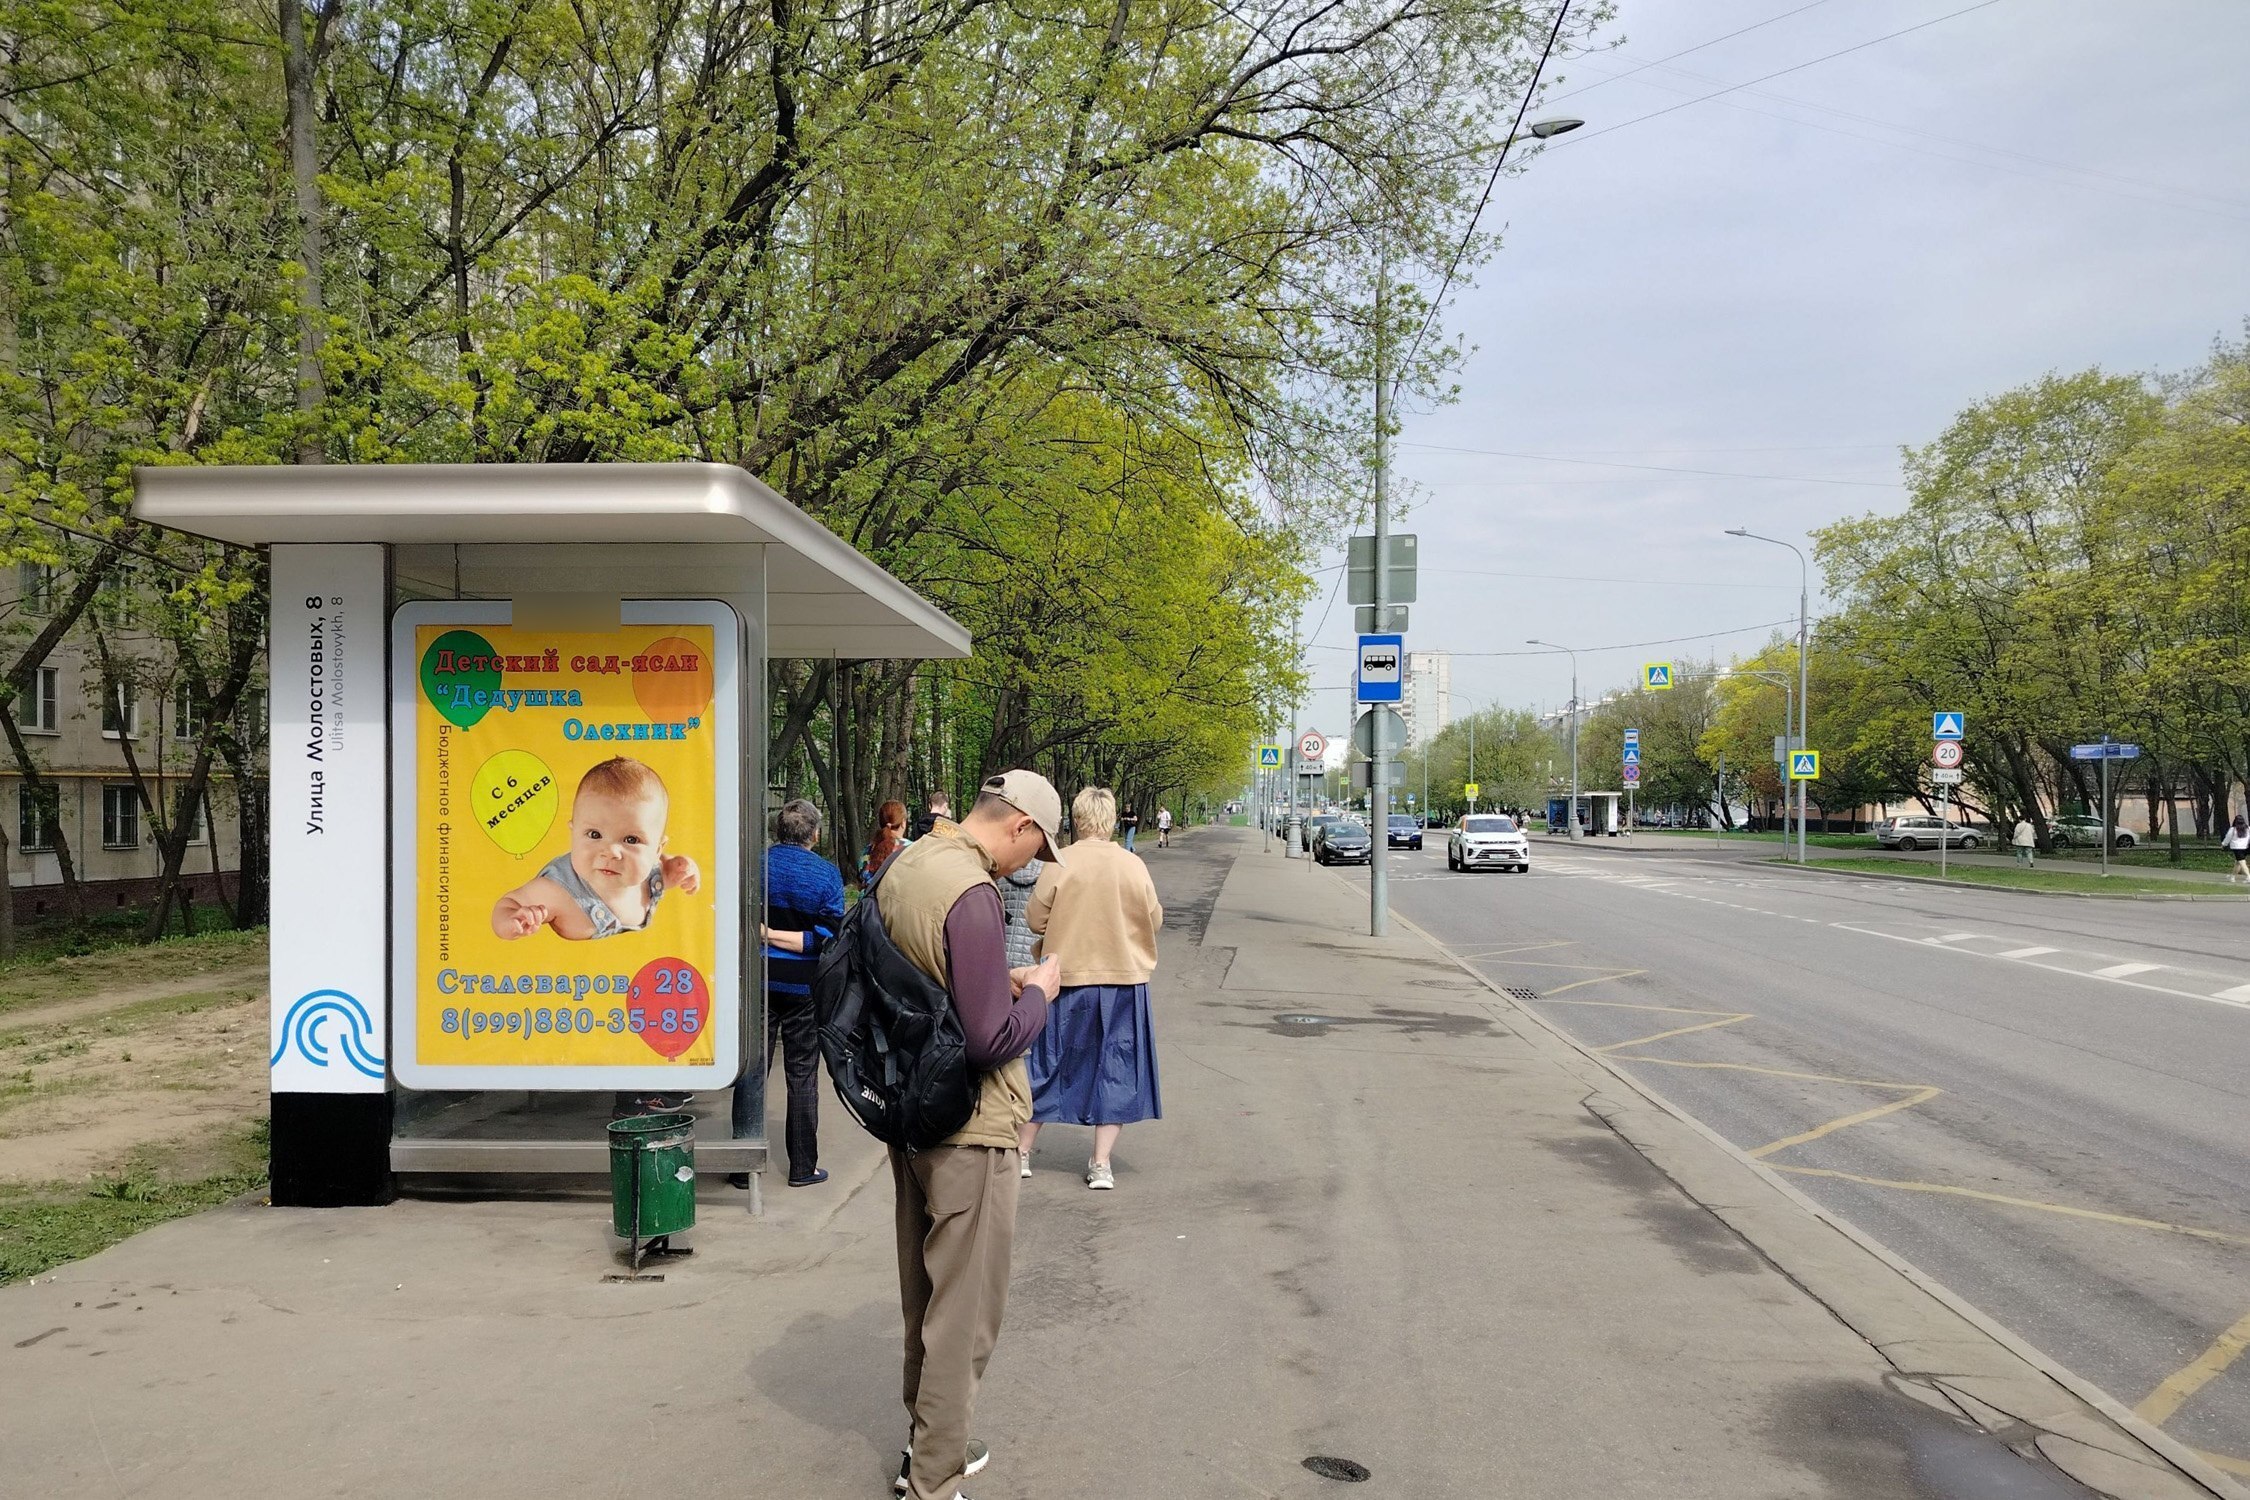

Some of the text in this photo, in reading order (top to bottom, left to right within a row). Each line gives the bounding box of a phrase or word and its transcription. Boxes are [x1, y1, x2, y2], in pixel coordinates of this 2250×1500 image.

[329, 596, 346, 751] Ulitsa Molostovykh, 8
[433, 648, 699, 676] Детский сад-ясли
[306, 596, 326, 835] Улица Молостовых, 8
[1305, 740, 1319, 751] 20
[1940, 748, 1956, 759] 20
[486, 775, 551, 829] месяцев
[491, 775, 518, 800] С 6
[436, 724, 452, 962] Бюджетное финансирование
[437, 968, 695, 1000] Сталеваров, 28
[440, 1007, 700, 1041] 8(999)880-35-85
